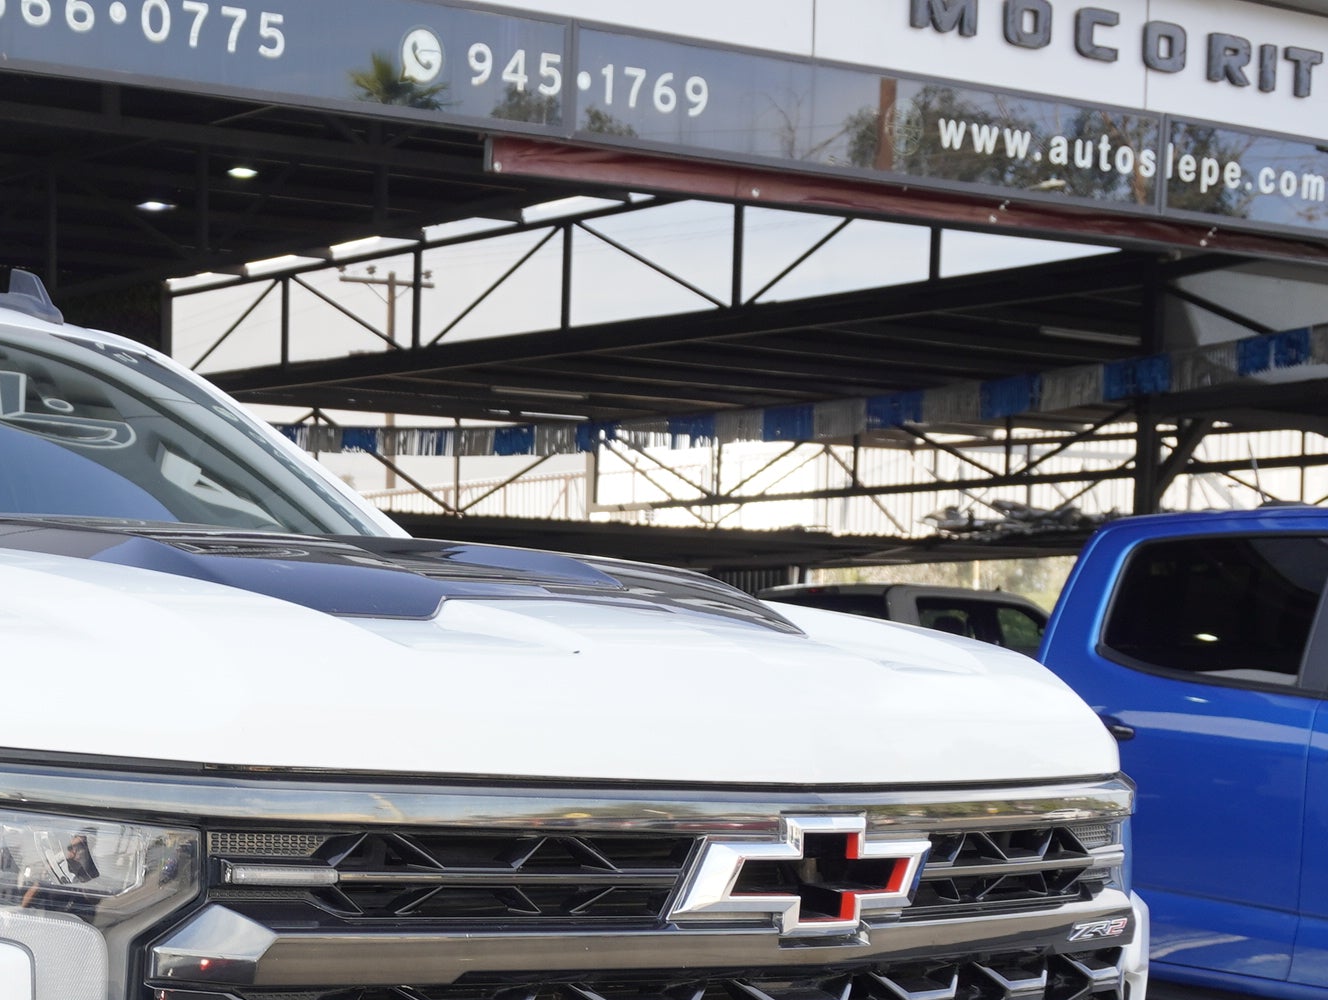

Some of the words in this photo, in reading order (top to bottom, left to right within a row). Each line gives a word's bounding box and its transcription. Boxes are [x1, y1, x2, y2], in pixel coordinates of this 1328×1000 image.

[909, 0, 1324, 98] MOCORIT
[938, 117, 1326, 202] www.autoslepe.com
[1067, 917, 1128, 942] ZR2
